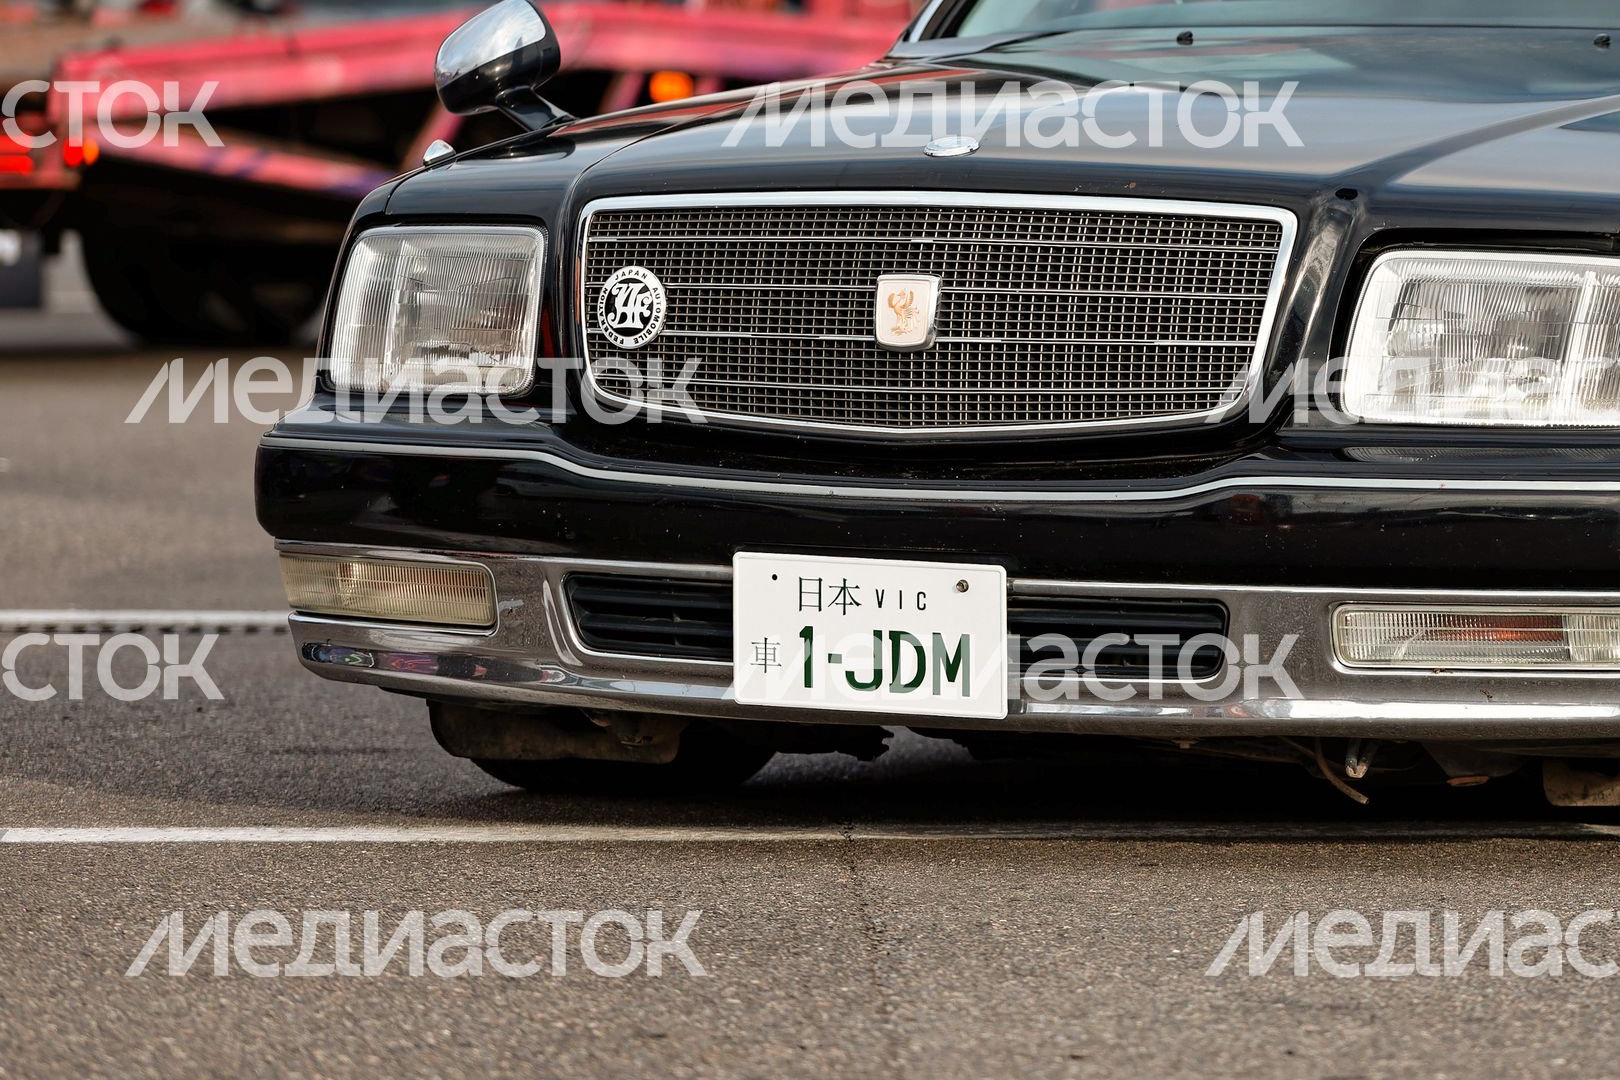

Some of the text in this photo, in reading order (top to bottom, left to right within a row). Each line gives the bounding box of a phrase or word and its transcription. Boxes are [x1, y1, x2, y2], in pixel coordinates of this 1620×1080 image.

[598, 269, 662, 345] JAPAN AUTOMOBILE FEDERATION
[798, 576, 927, 616] 日本 VIC
[750, 637, 782, 674] 車
[799, 625, 971, 698] 1-JDM
